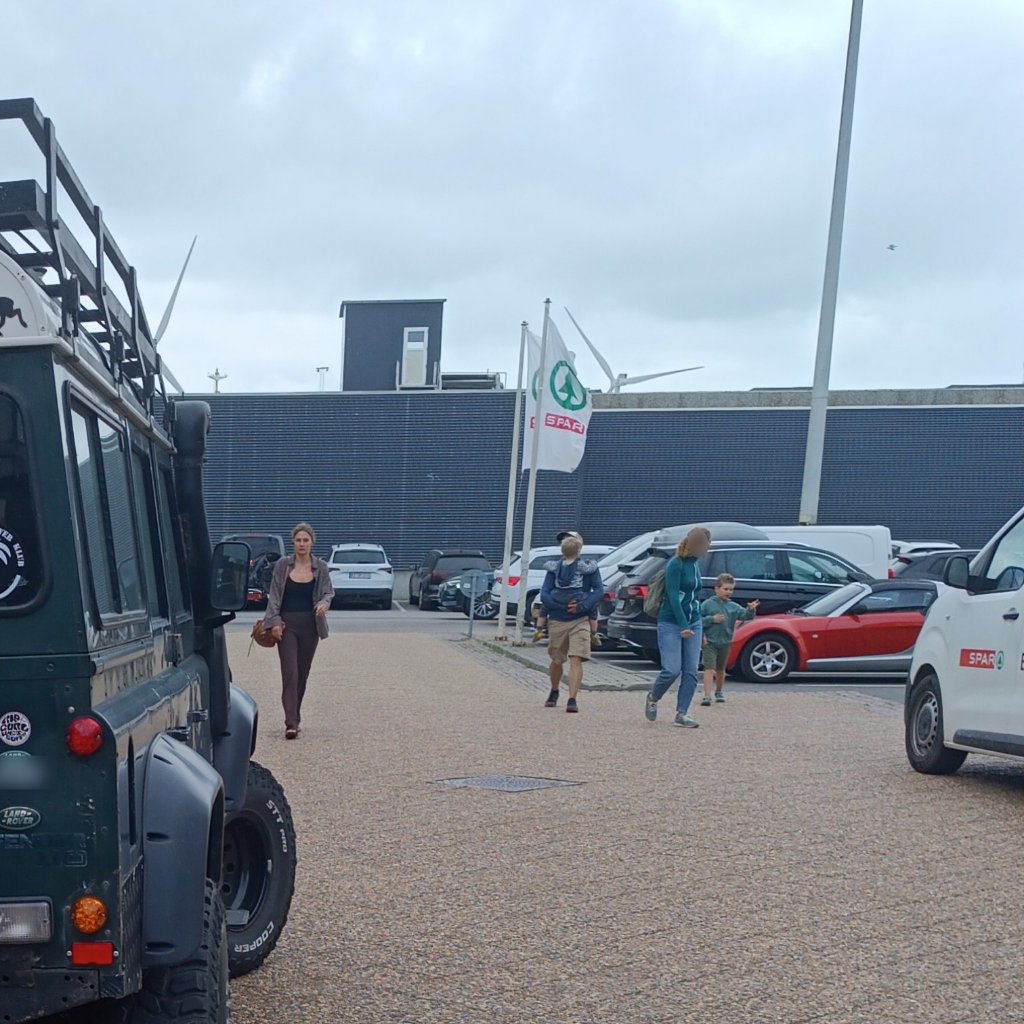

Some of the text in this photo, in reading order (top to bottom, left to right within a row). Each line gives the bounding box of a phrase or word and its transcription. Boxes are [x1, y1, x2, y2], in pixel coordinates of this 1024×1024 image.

[546, 415, 584, 433] SPAR
[12, 542, 25, 567] KLUB
[969, 652, 995, 666] SPAR
[265, 800, 288, 853] STT PRO
[234, 920, 275, 953] COOPER
